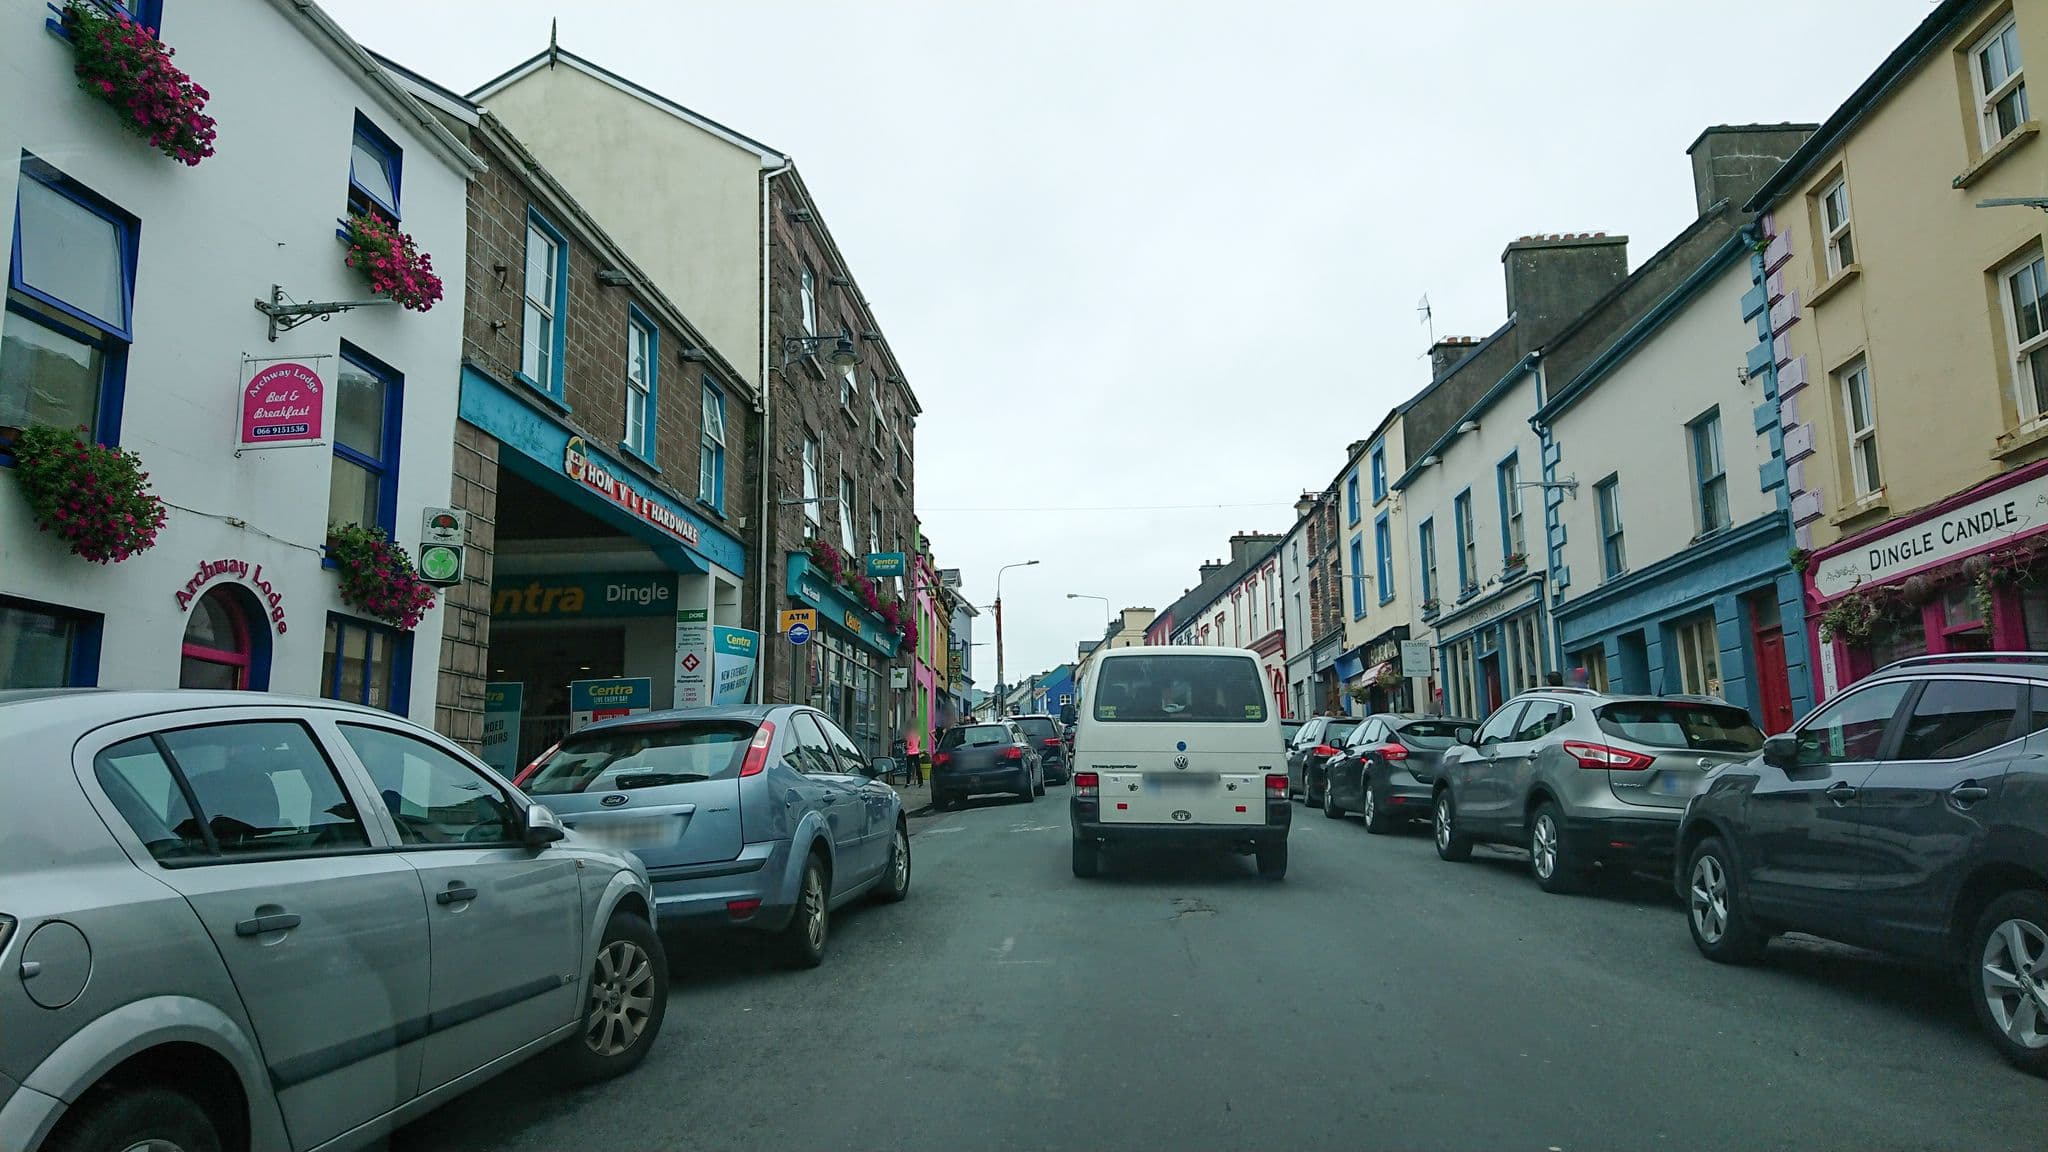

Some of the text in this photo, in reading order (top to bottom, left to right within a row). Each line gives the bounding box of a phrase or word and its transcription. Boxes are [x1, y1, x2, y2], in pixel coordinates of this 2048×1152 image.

[249, 368, 319, 398] Archway Lodge
[265, 390, 300, 403] Bed &
[253, 405, 310, 419] Breakfast
[256, 427, 271, 435] 066
[651, 503, 698, 544] HARDWARE
[1869, 501, 2018, 572] DINGLE CANDLE
[872, 558, 899, 566] Centra
[176, 559, 287, 634] Archway Lodge
[493, 581, 669, 615] ntra Dingle
[789, 613, 809, 621] ATM
[726, 633, 751, 648] Centra
[588, 685, 633, 697] Centra
